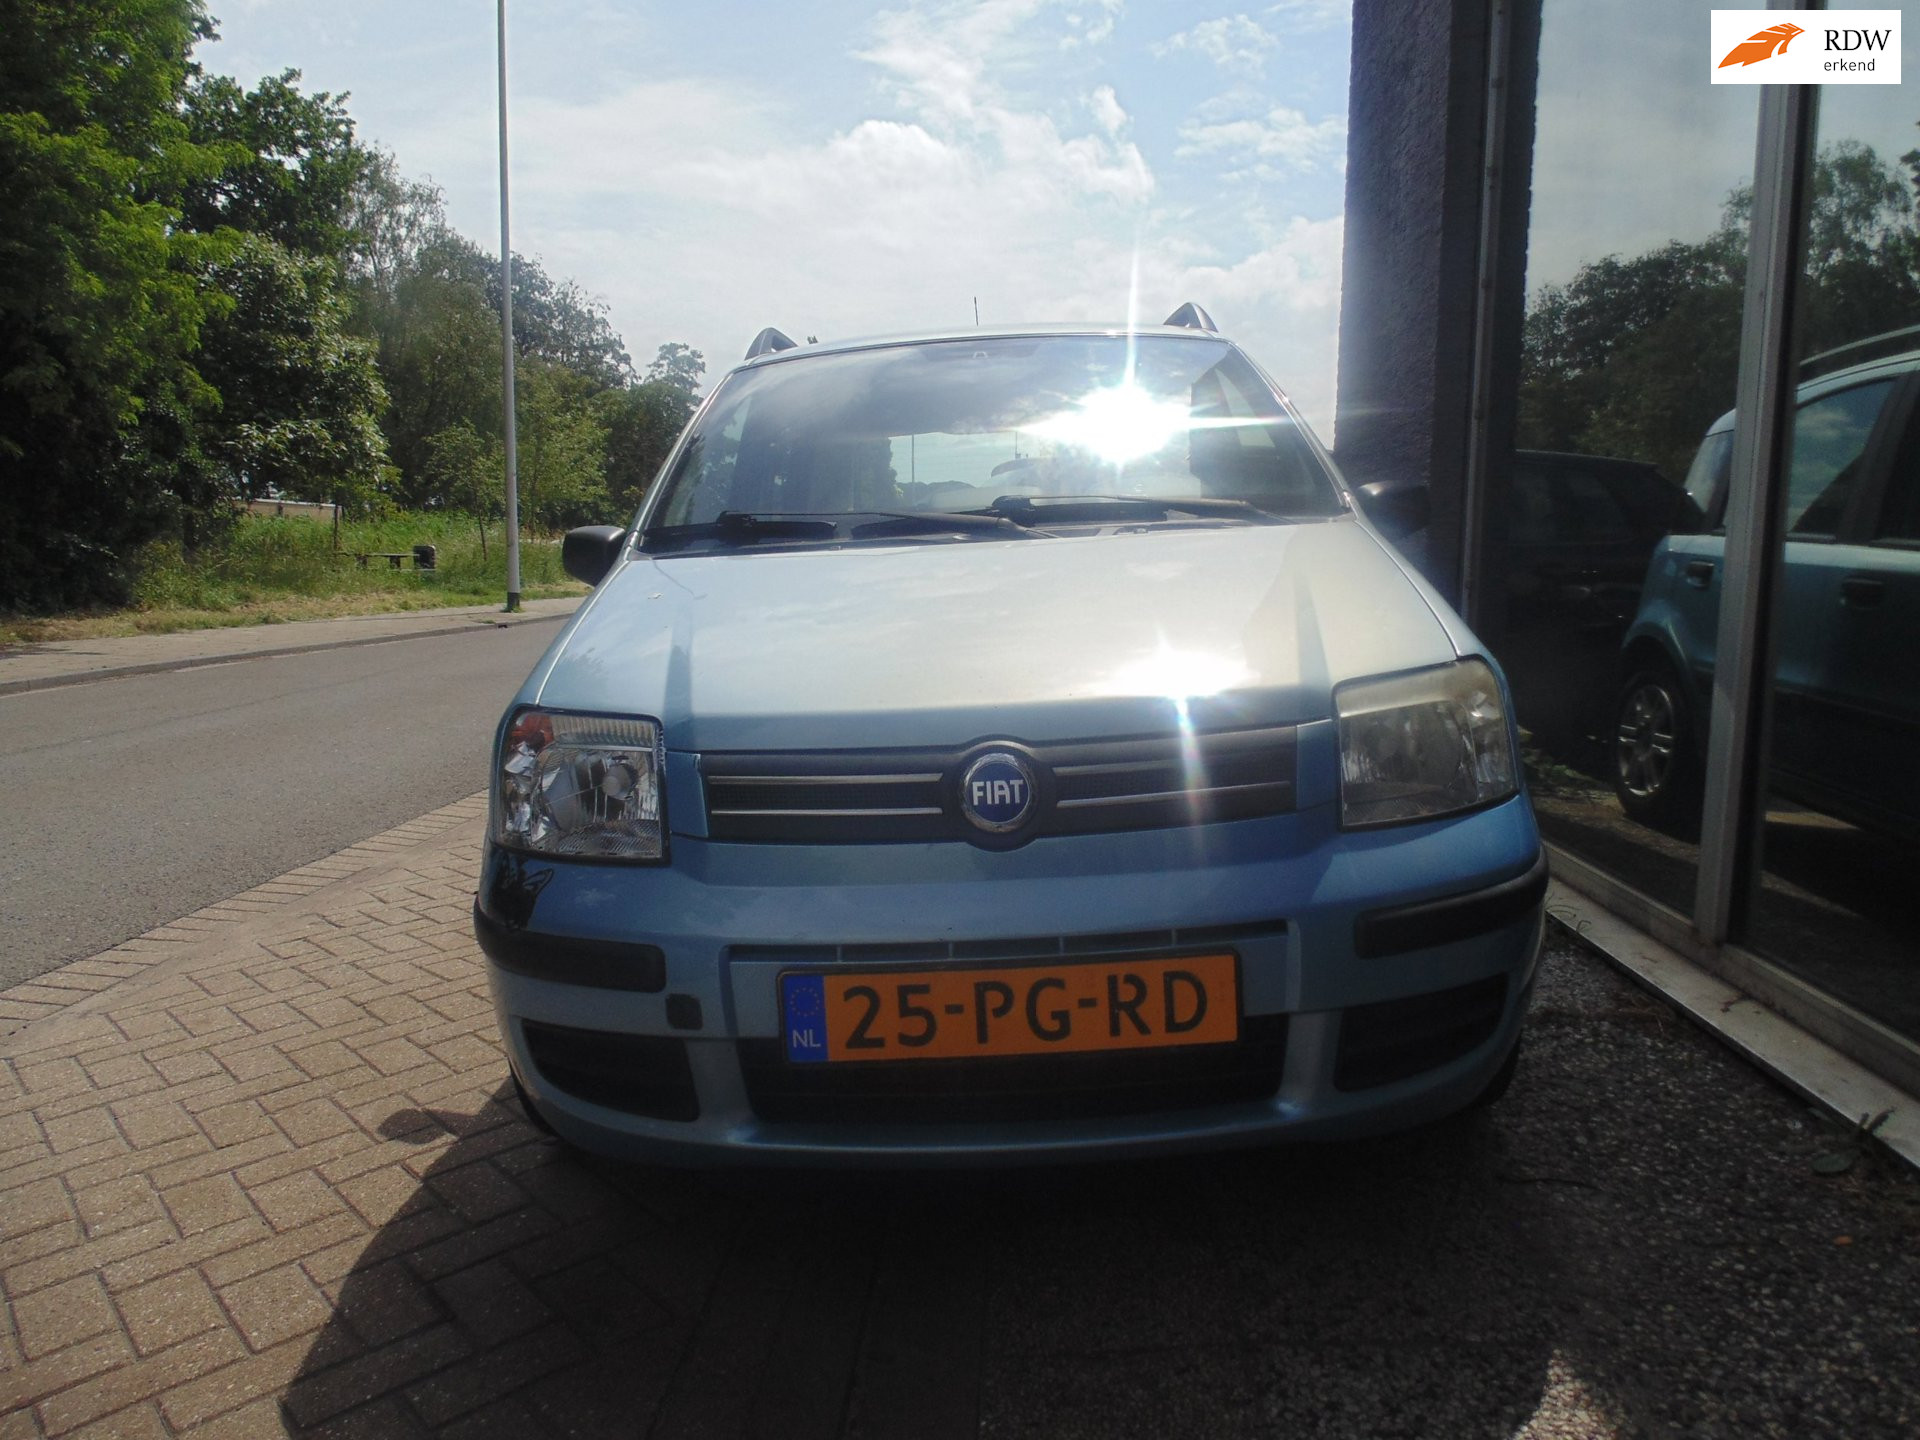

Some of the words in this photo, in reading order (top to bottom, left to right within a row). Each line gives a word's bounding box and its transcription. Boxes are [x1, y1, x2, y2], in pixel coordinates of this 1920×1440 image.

[972, 779, 1024, 806] FIAT
[843, 970, 1208, 1050] 25-PG-RD
[792, 1029, 821, 1048] NL
